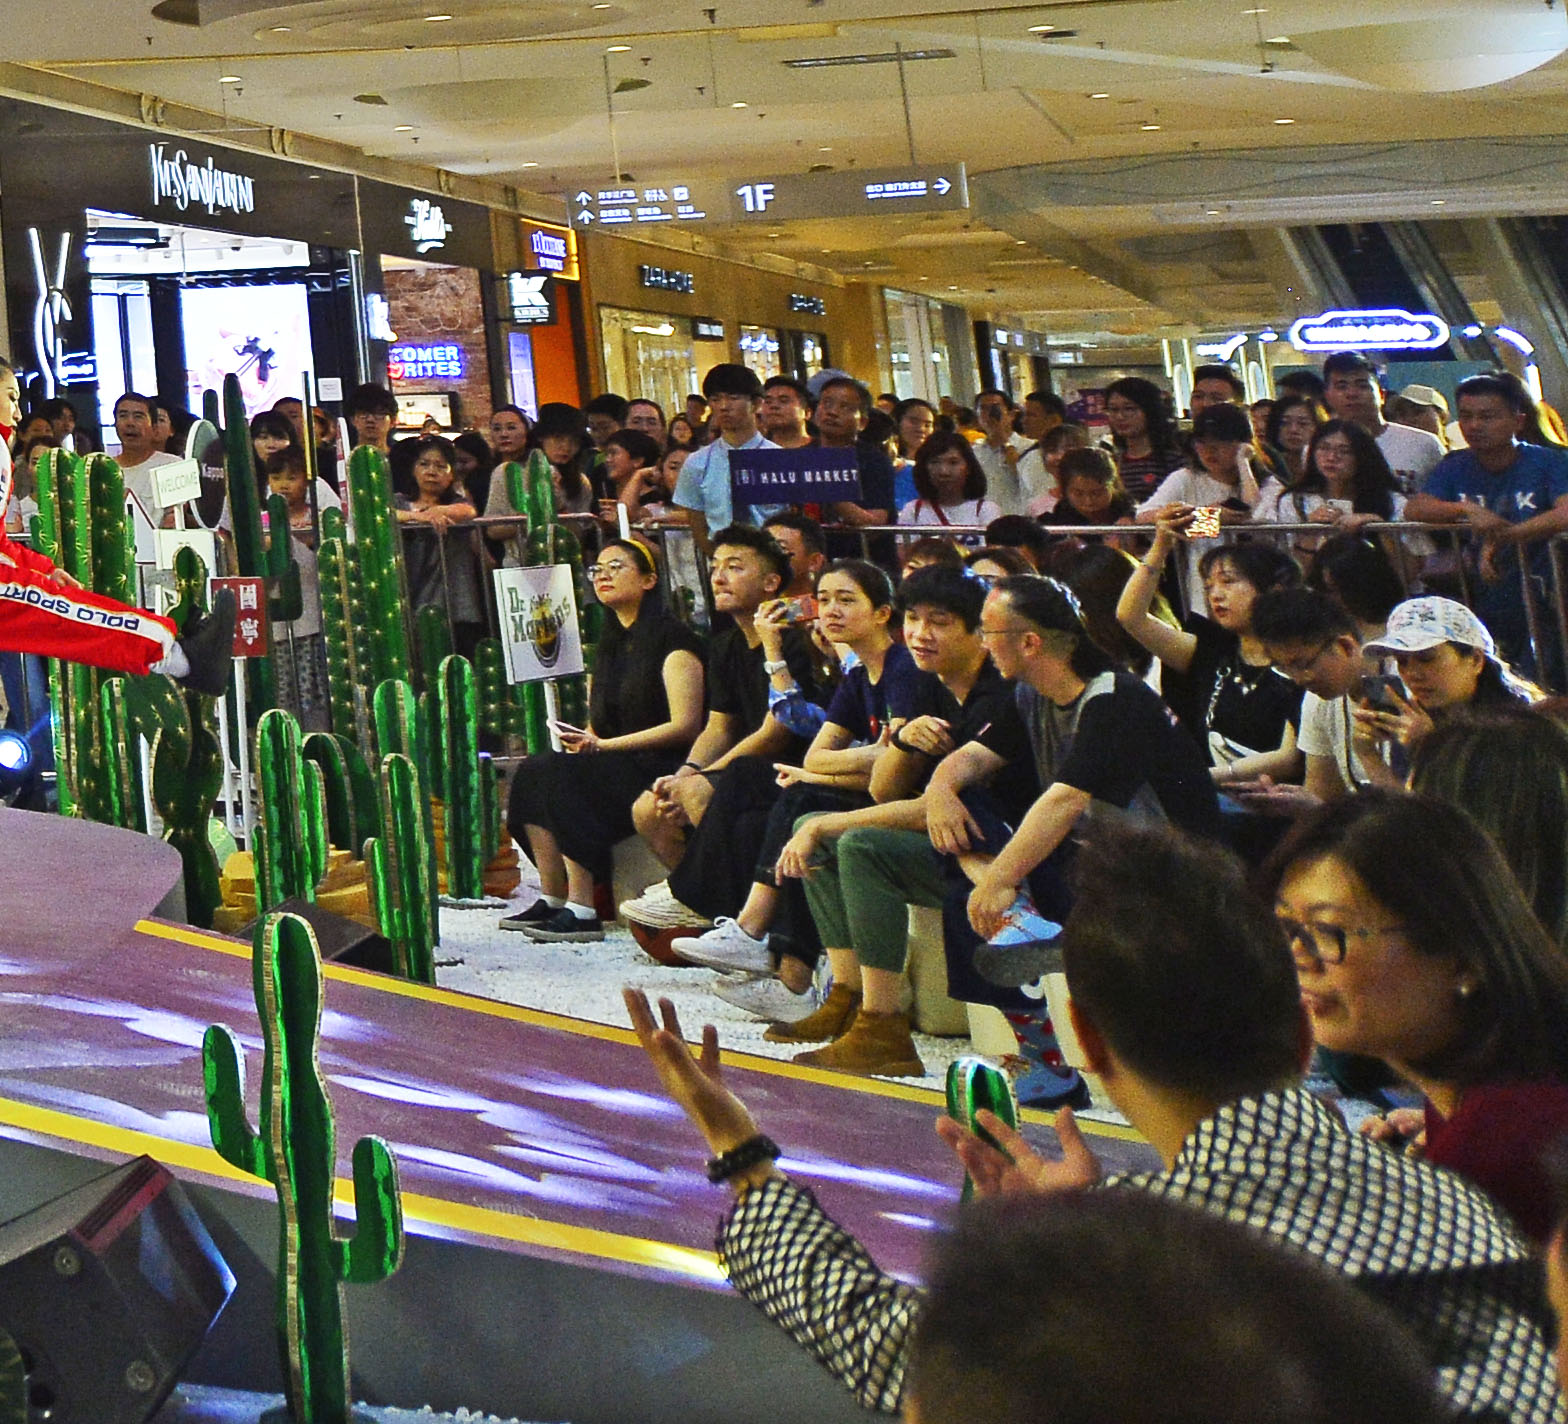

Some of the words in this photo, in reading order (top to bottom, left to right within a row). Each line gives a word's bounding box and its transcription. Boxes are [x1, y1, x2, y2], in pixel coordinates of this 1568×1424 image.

[736, 183, 775, 213] 1F
[0, 584, 71, 614] SPORT
[77, 608, 140, 631] POLO
